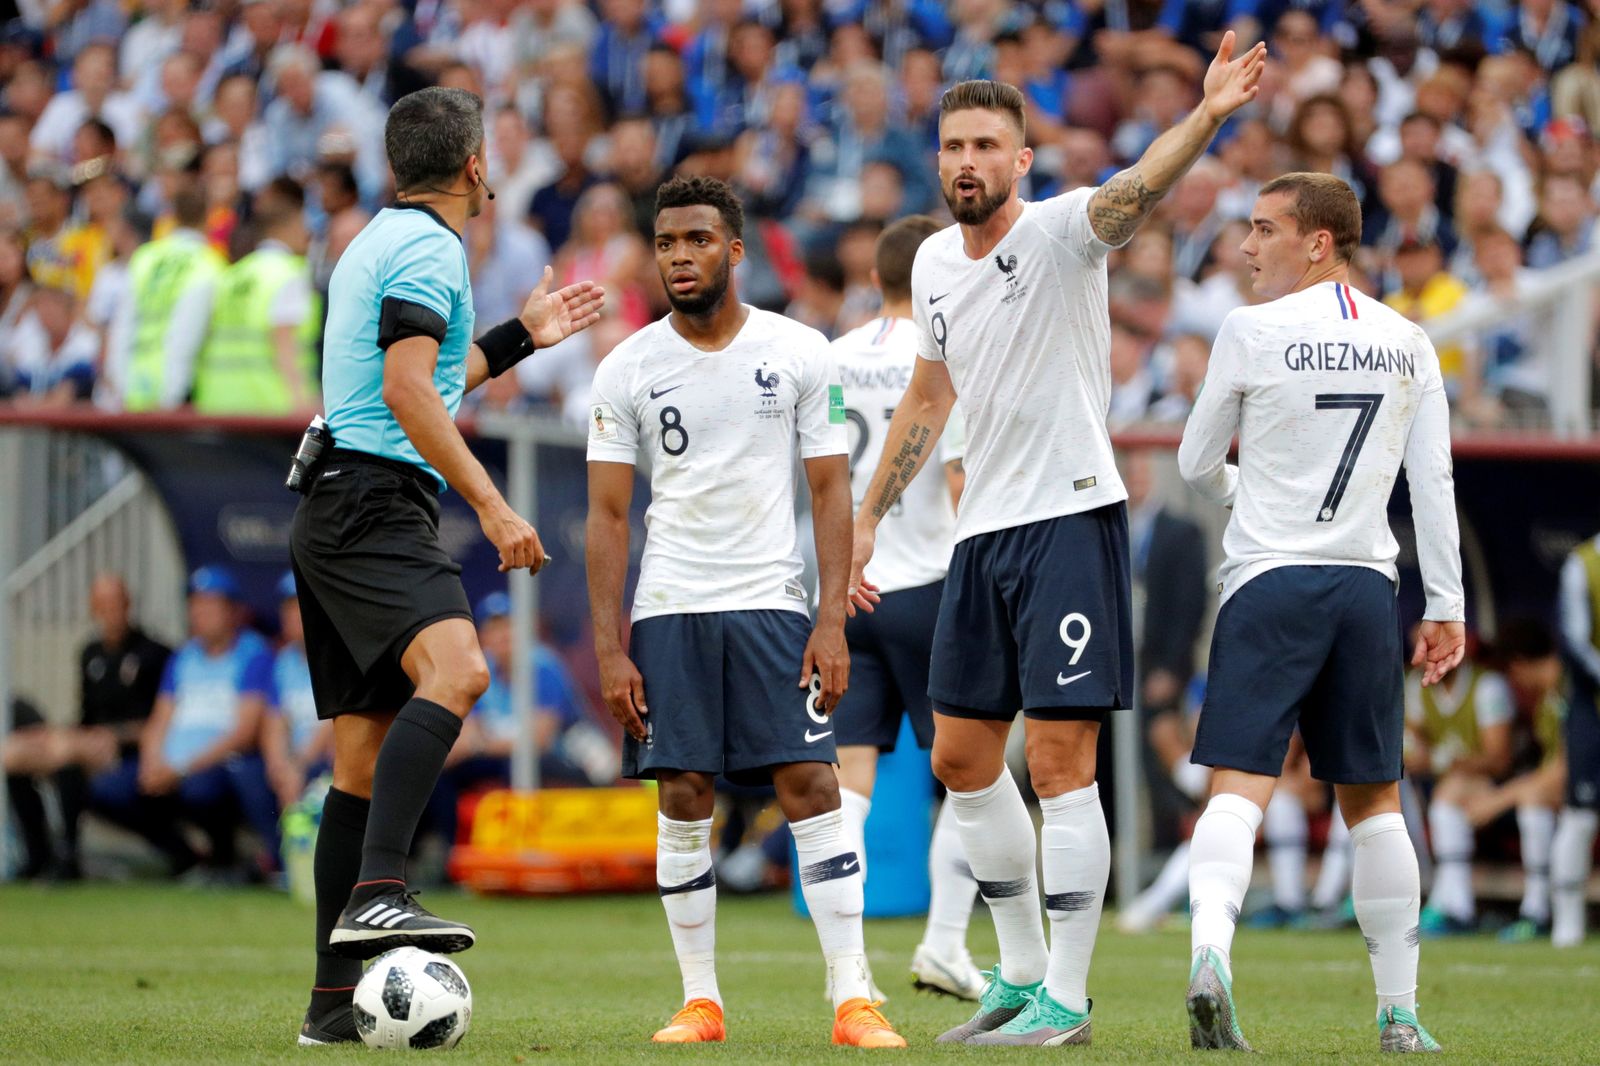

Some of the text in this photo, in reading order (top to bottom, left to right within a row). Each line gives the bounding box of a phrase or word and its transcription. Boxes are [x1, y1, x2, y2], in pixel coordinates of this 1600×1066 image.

[932, 312, 947, 361] 9
[1285, 342, 1415, 379] GRIEZMANN
[660, 406, 689, 456] 8
[1315, 394, 1384, 522] 7
[1059, 612, 1091, 666] 9
[806, 673, 830, 724] 8
